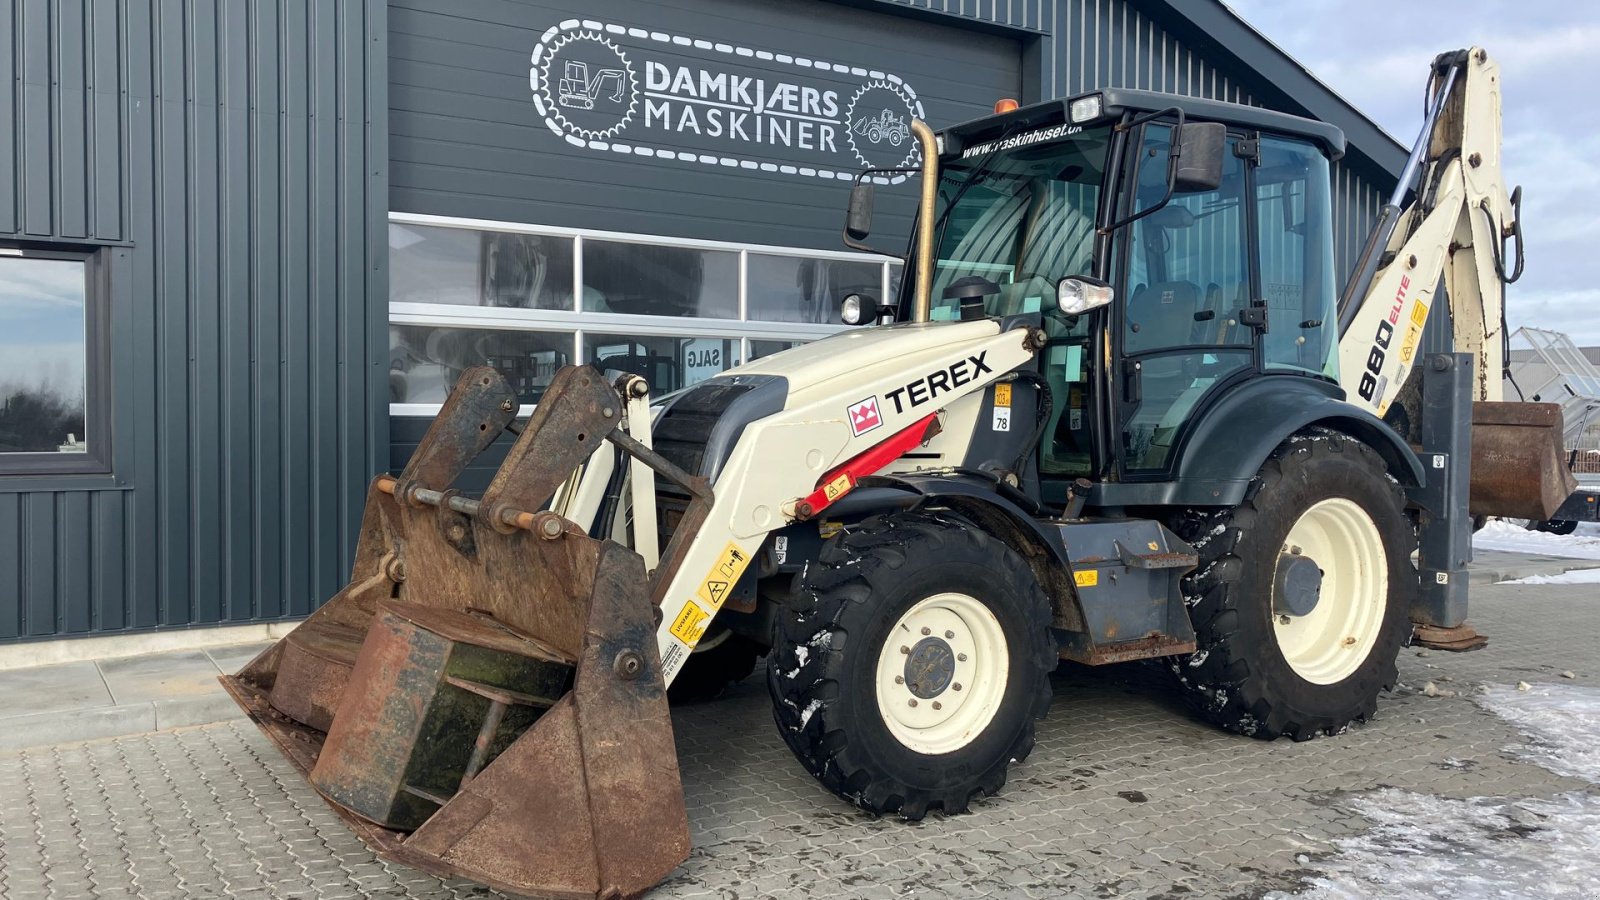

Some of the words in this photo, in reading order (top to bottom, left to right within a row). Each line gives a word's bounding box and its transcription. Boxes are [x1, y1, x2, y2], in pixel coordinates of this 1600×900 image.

[645, 60, 839, 118] DAMKJÆRS
[644, 98, 837, 153] MASKINER
[1358, 319, 1393, 402] 880
[1388, 274, 1411, 326] ELITE
[884, 350, 993, 415] TEREX
[996, 417, 1008, 430] 78
